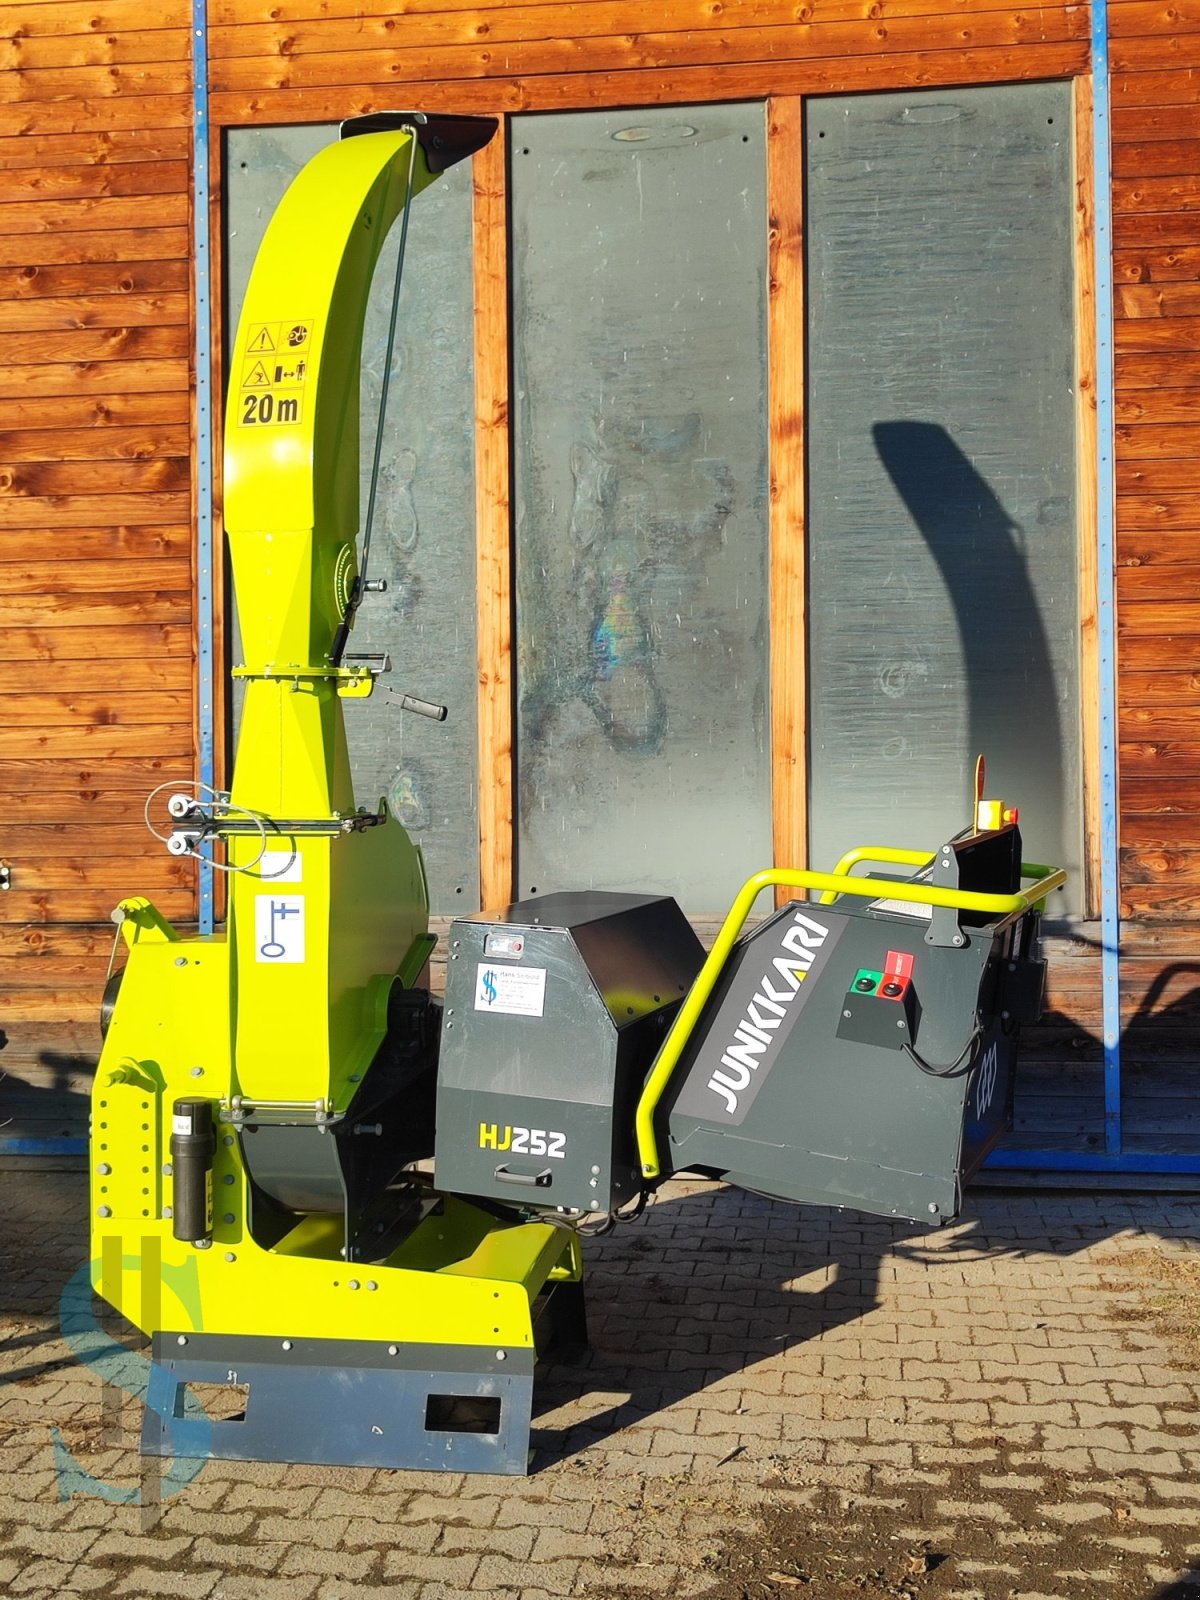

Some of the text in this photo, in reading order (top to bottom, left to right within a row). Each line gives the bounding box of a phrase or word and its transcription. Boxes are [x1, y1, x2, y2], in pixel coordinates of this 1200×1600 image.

[243, 394, 298, 424] 20 m
[707, 912, 829, 1115] JUNKKARI
[479, 1122, 567, 1159] HJ252
